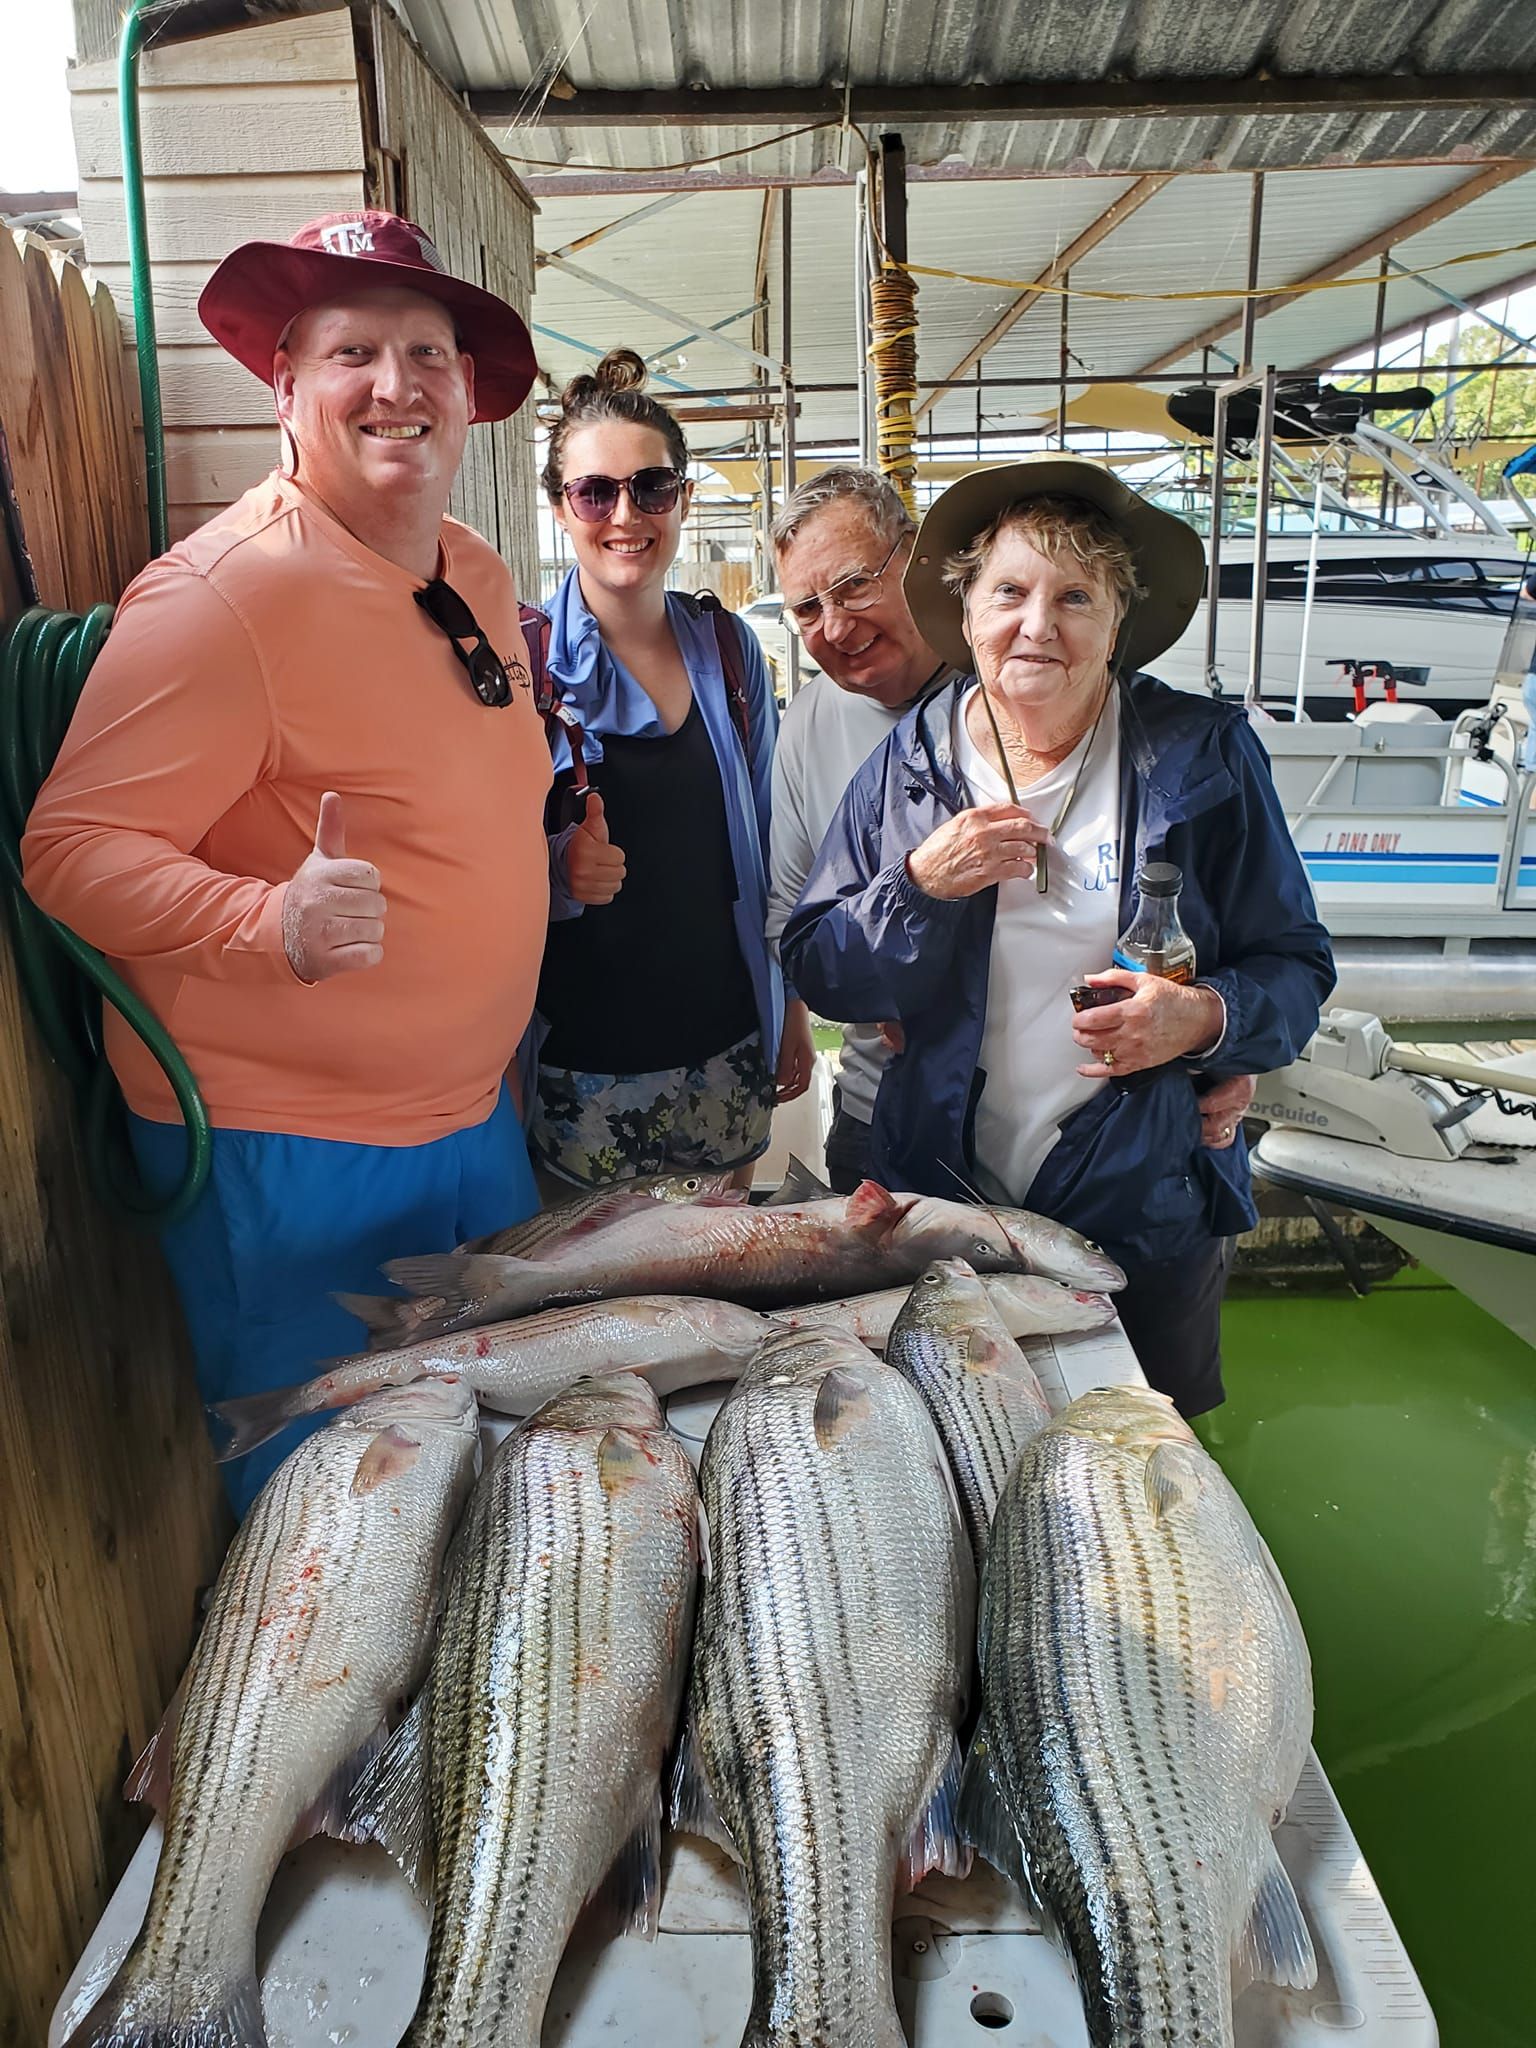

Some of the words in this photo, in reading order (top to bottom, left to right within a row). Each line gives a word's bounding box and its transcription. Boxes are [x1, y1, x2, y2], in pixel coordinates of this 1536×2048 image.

[1098, 843, 1114, 864] R
[1371, 832, 1402, 854] ONLY
[1248, 1102, 1328, 1127] orGuide
